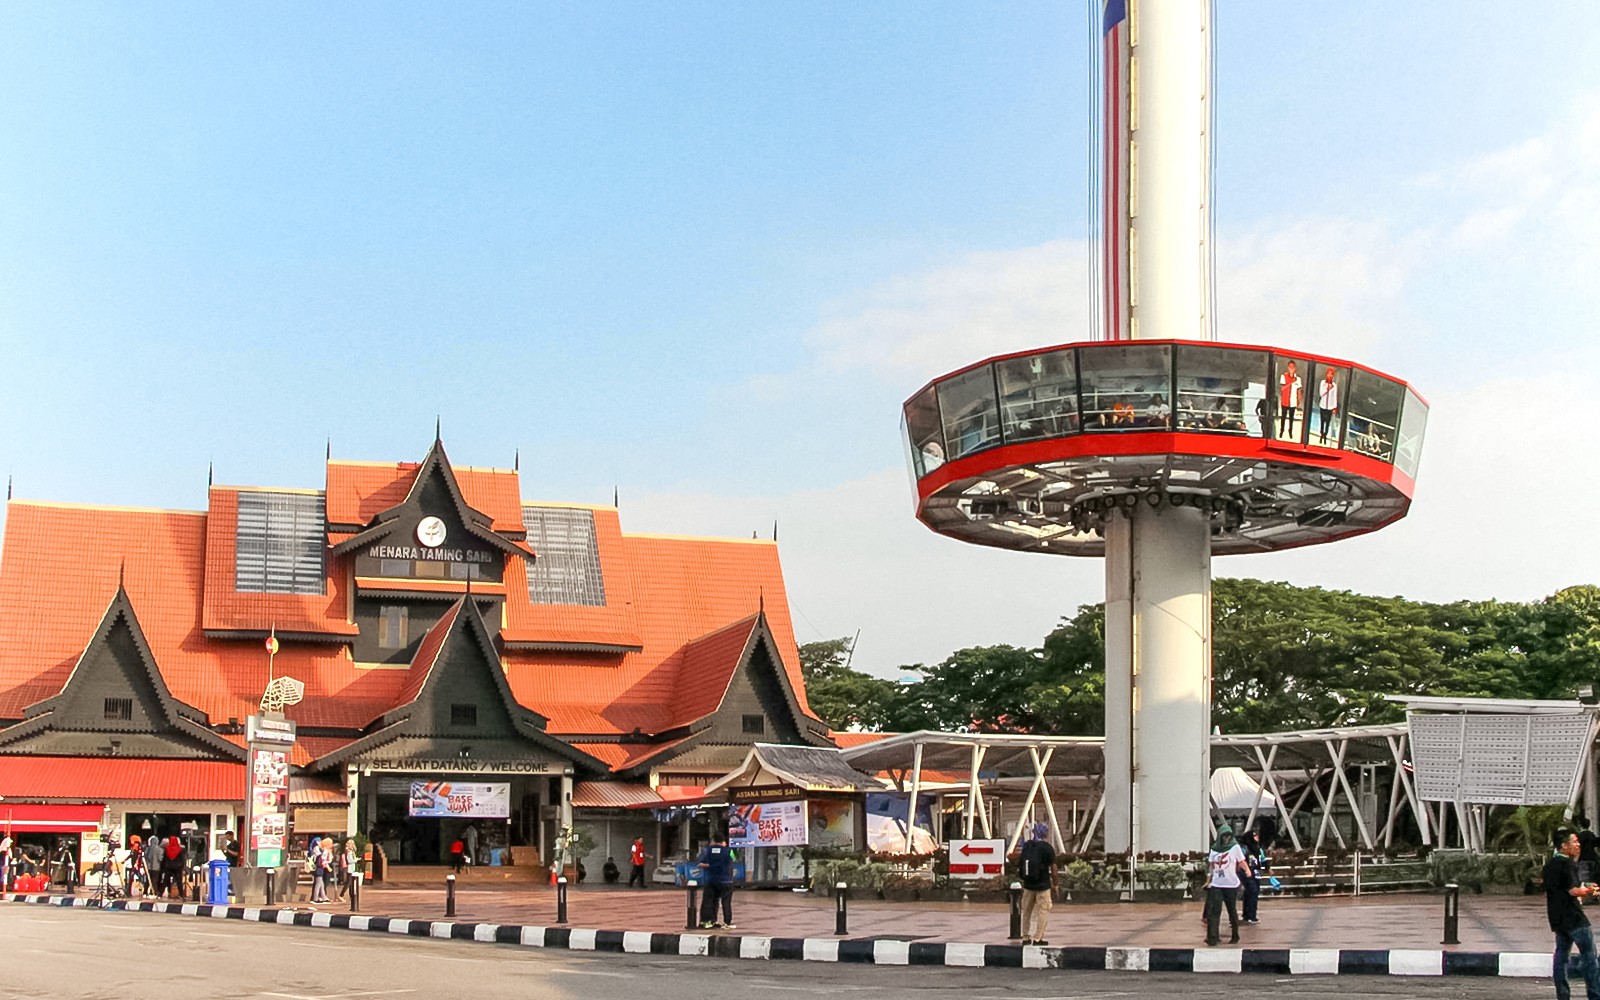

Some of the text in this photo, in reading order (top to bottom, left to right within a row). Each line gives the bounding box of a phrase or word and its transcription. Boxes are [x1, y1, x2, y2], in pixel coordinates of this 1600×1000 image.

[370, 546, 492, 563] MENARA TAMING SARI
[372, 760, 430, 770] SELAMAT
[431, 761, 478, 771] DATANG
[490, 762, 549, 773] WELCOME
[736, 790, 760, 798] ASTANA
[785, 788, 800, 796] SARI
[448, 795, 472, 804] BASE
[447, 803, 474, 813] JUMP
[759, 819, 782, 830] BASE
[758, 829, 783, 842] JUMP
